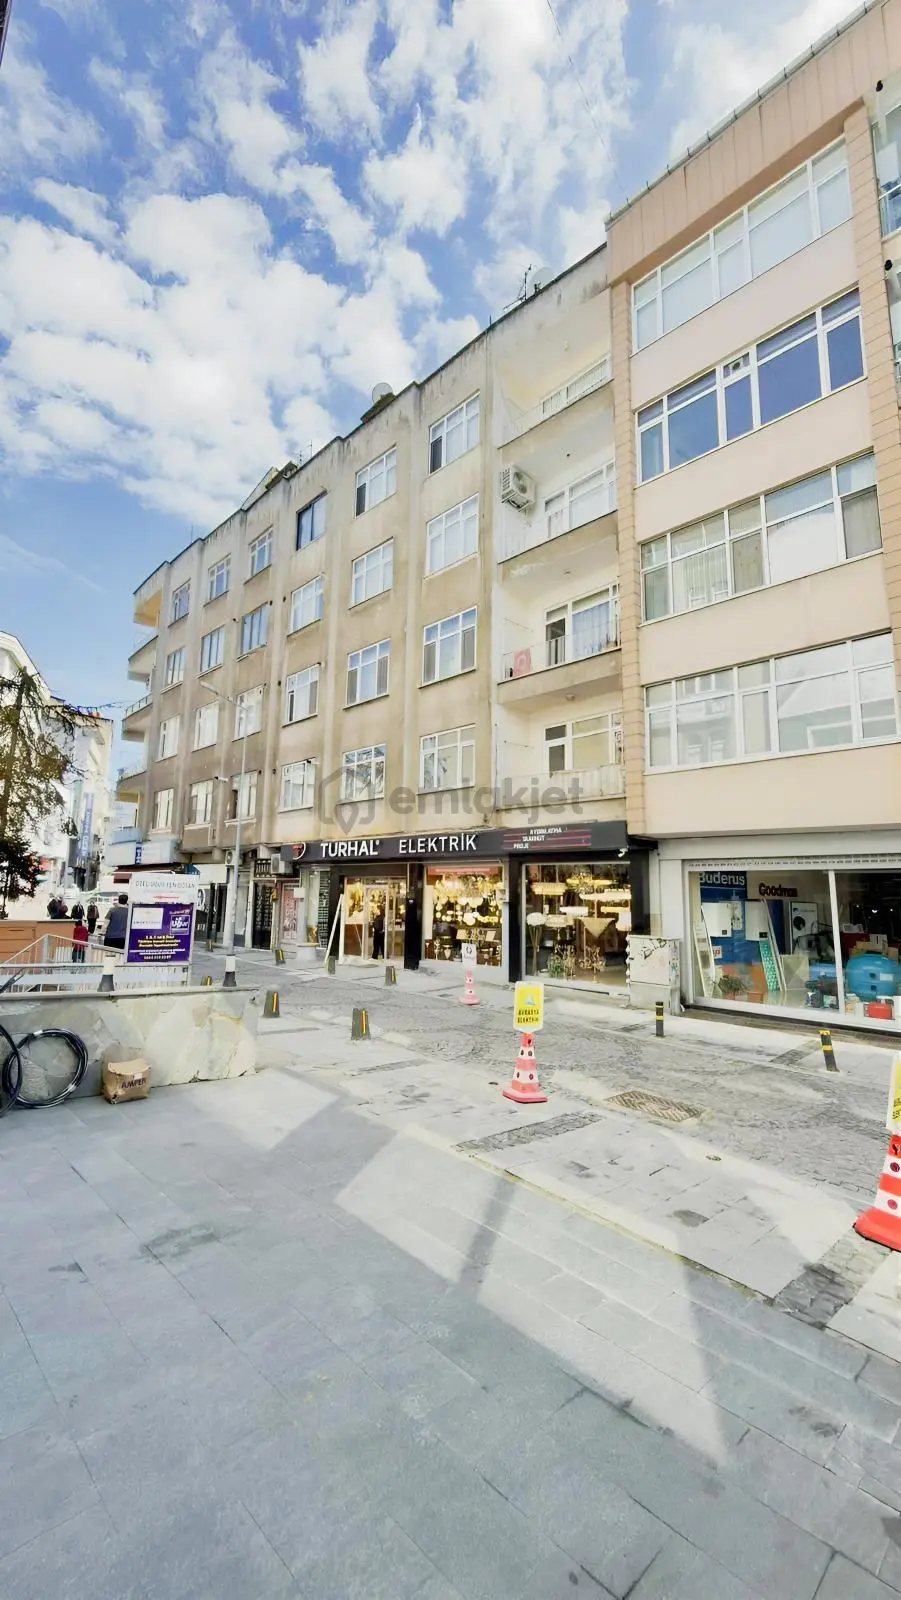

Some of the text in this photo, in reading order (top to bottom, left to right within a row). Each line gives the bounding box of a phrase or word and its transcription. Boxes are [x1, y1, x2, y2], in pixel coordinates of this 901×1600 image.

[320, 833, 477, 858] TURHAL ELEKTRİK
[698, 870, 746, 886] Buderus
